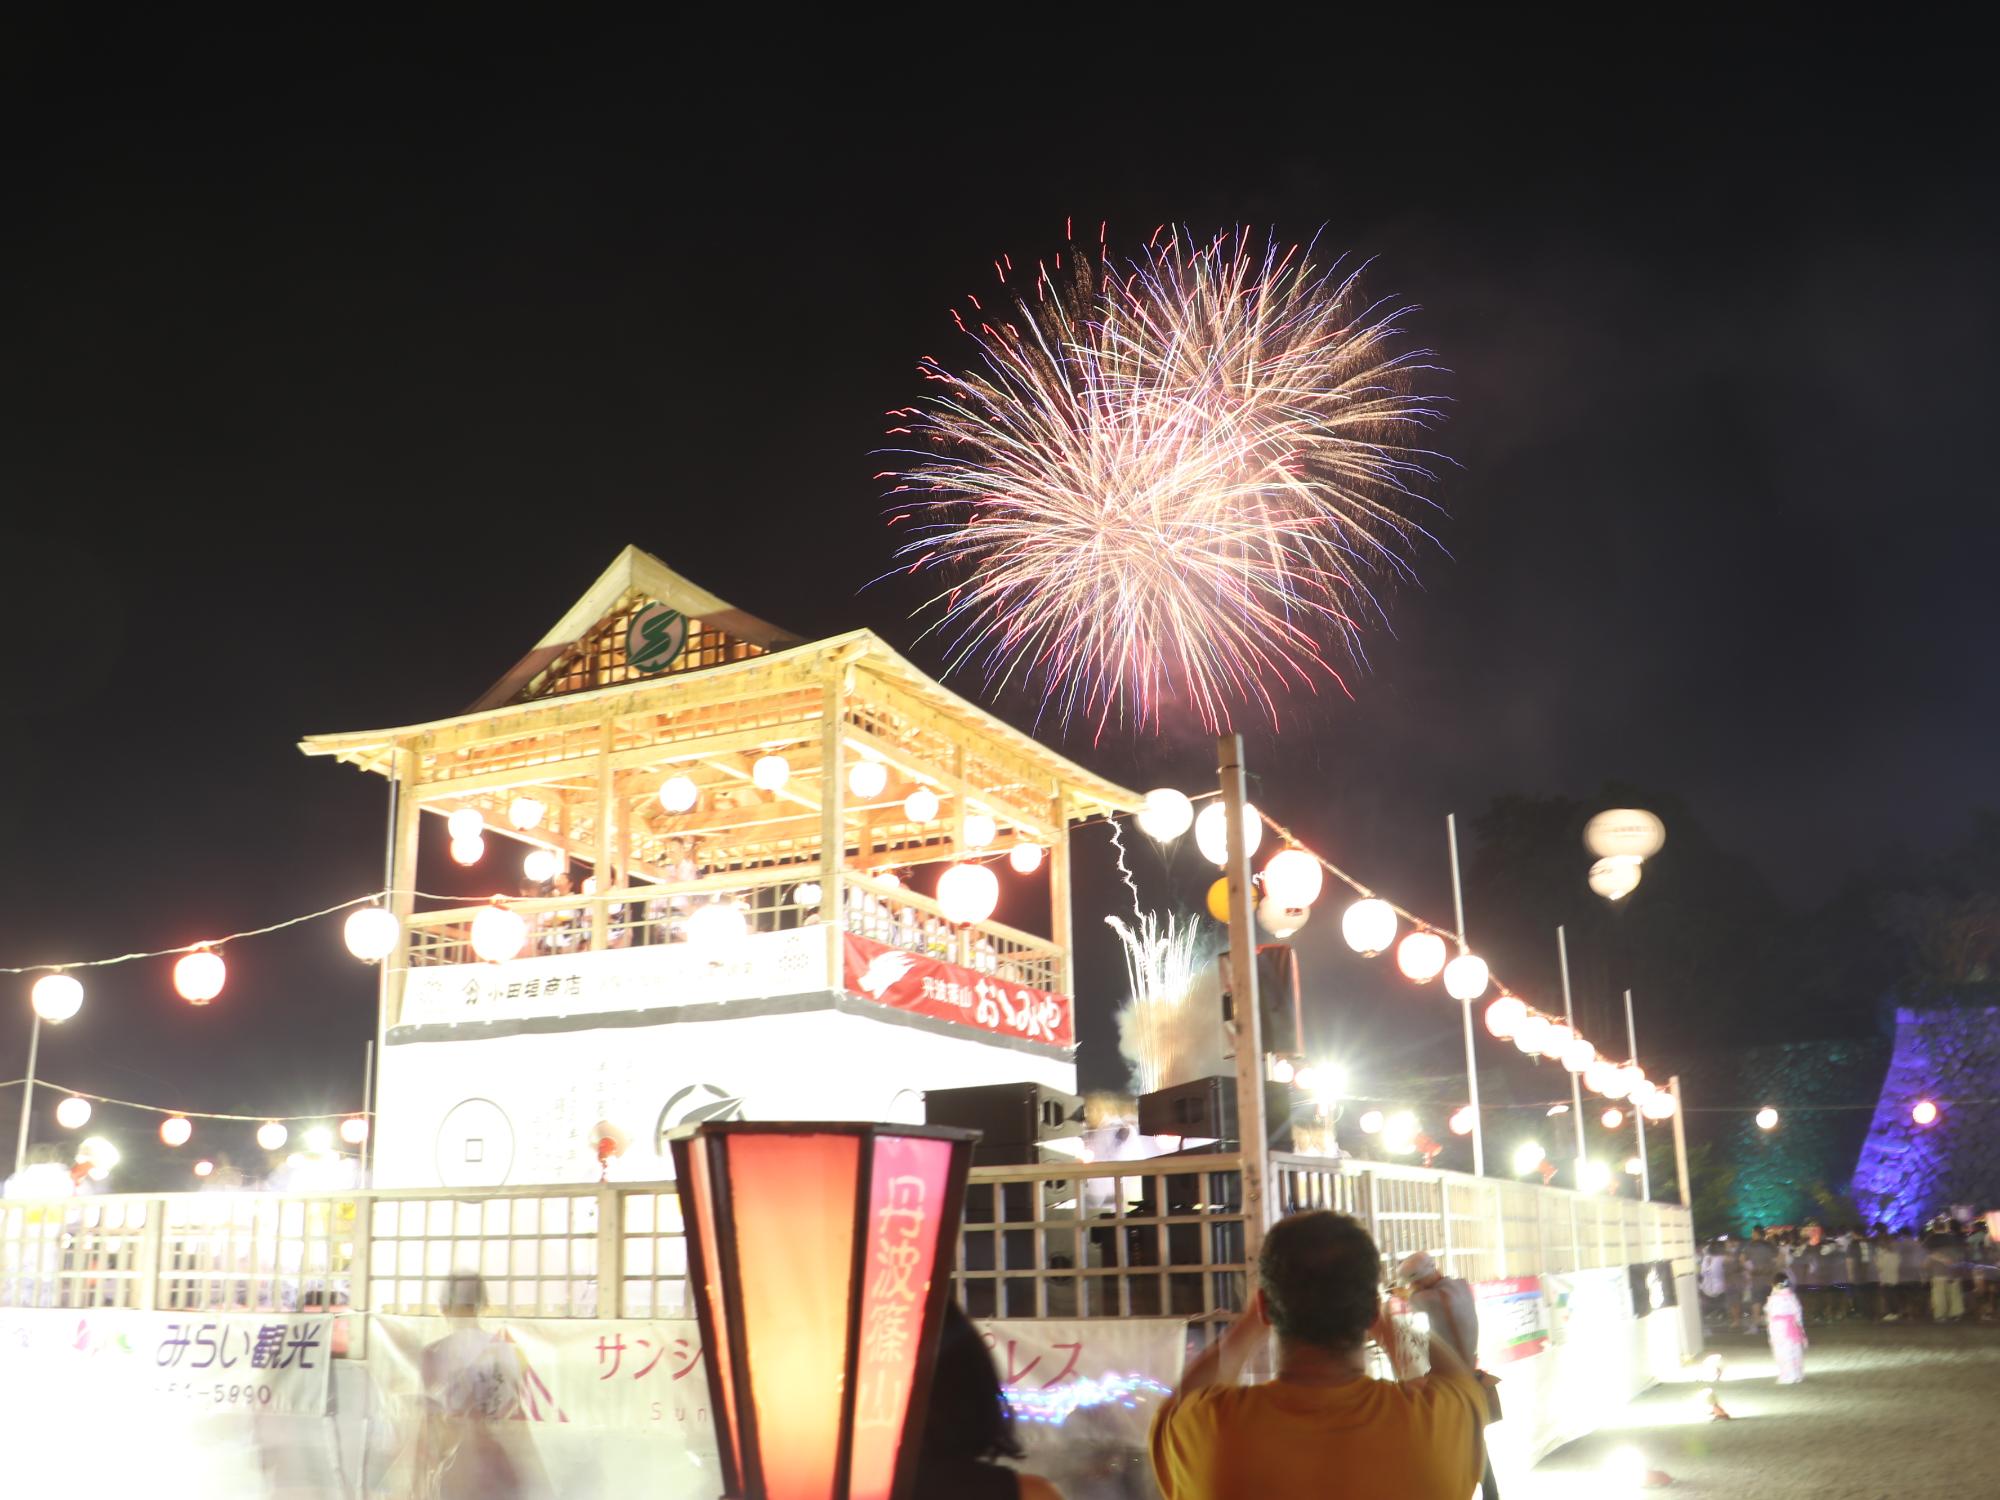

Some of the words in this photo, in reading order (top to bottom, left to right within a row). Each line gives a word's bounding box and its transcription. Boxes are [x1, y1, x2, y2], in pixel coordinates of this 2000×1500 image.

[857, 1175, 926, 1428] 丹波篠山
[156, 1323, 321, 1369] みらい観光
[982, 1332, 1083, 1389] レス
